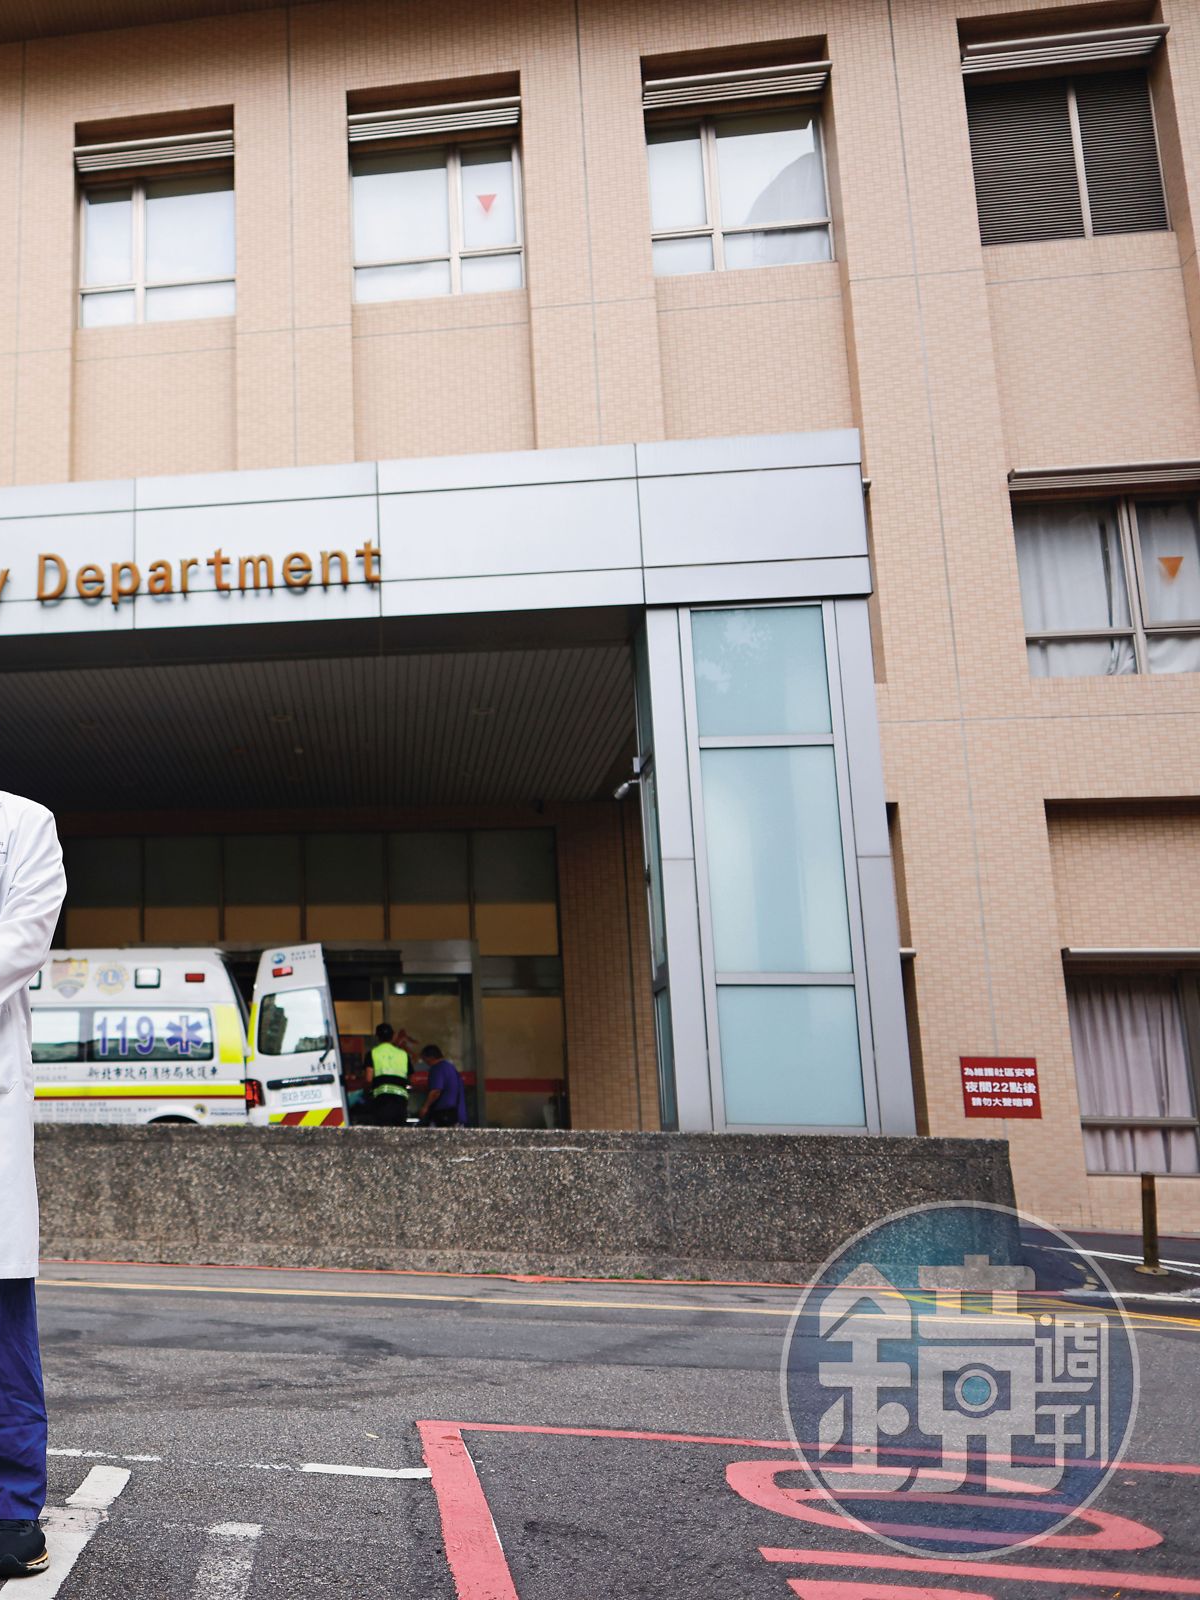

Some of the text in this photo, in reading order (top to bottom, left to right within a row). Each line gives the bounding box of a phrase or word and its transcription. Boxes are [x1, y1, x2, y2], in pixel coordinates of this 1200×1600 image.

[36, 539, 382, 605] Department
[96, 1015, 155, 1057] 119
[965, 1081, 1037, 1094] 夜間22點後
